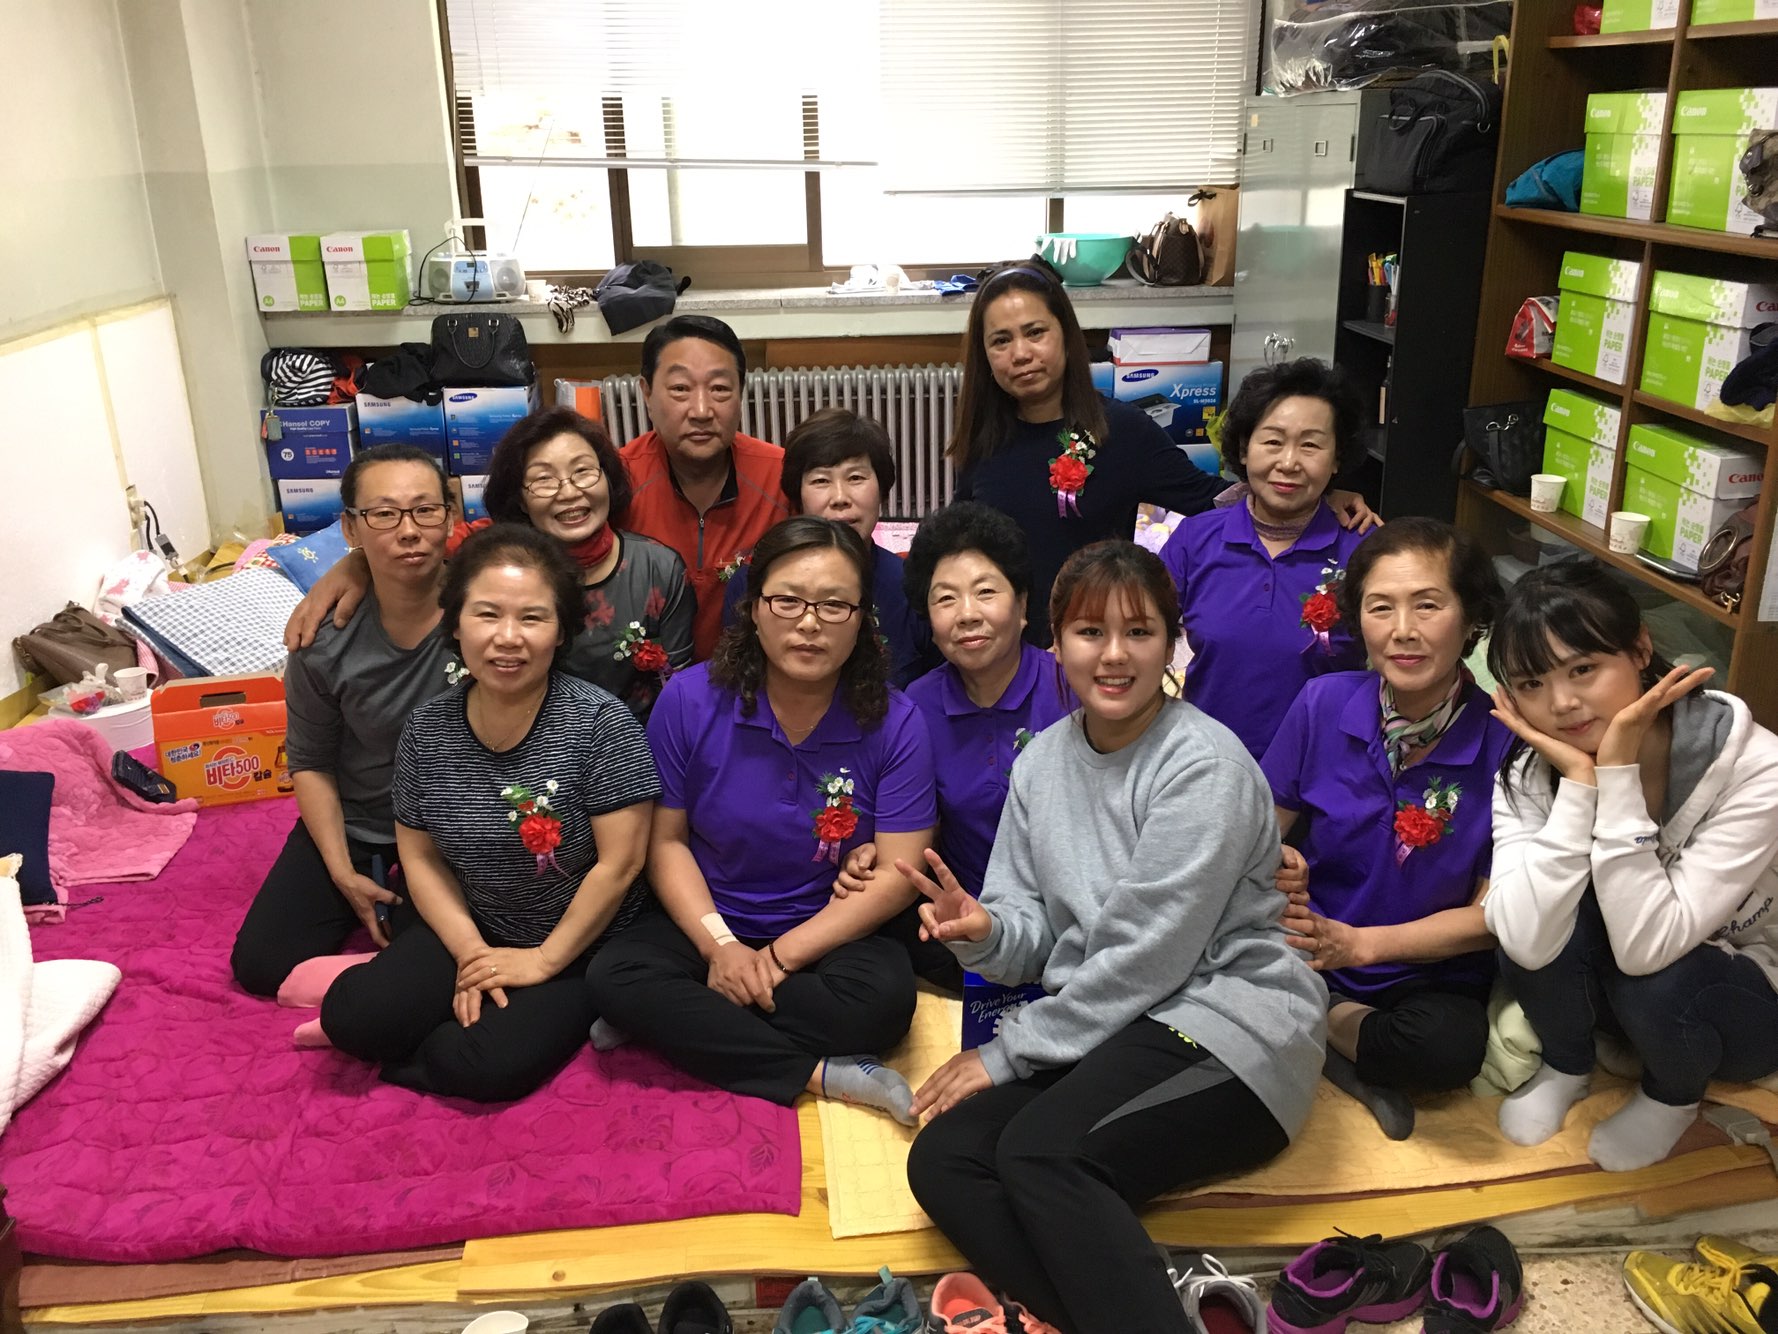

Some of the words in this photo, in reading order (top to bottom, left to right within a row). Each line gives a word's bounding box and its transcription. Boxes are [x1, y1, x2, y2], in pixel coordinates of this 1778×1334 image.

[1590, 106, 1611, 118] Canon
[1680, 106, 1707, 117] Canon
[253, 245, 281, 253] Canon
[326, 245, 353, 253] Canon
[1564, 265, 1584, 278] Canon
[300, 299, 324, 307] PAPER
[1603, 338, 1623, 352] PAPER
[1170, 383, 1217, 400] Xpress
[1550, 402, 1571, 417] Canon
[1632, 440, 1656, 458] Canon
[1589, 484, 1609, 500] PAPER
[1680, 526, 1704, 545] PAPER
[206, 756, 260, 786] 비타500
[253, 769, 272, 782] 칼슘
[970, 998, 1001, 1014] Drive
[1002, 992, 1027, 1004] Your
